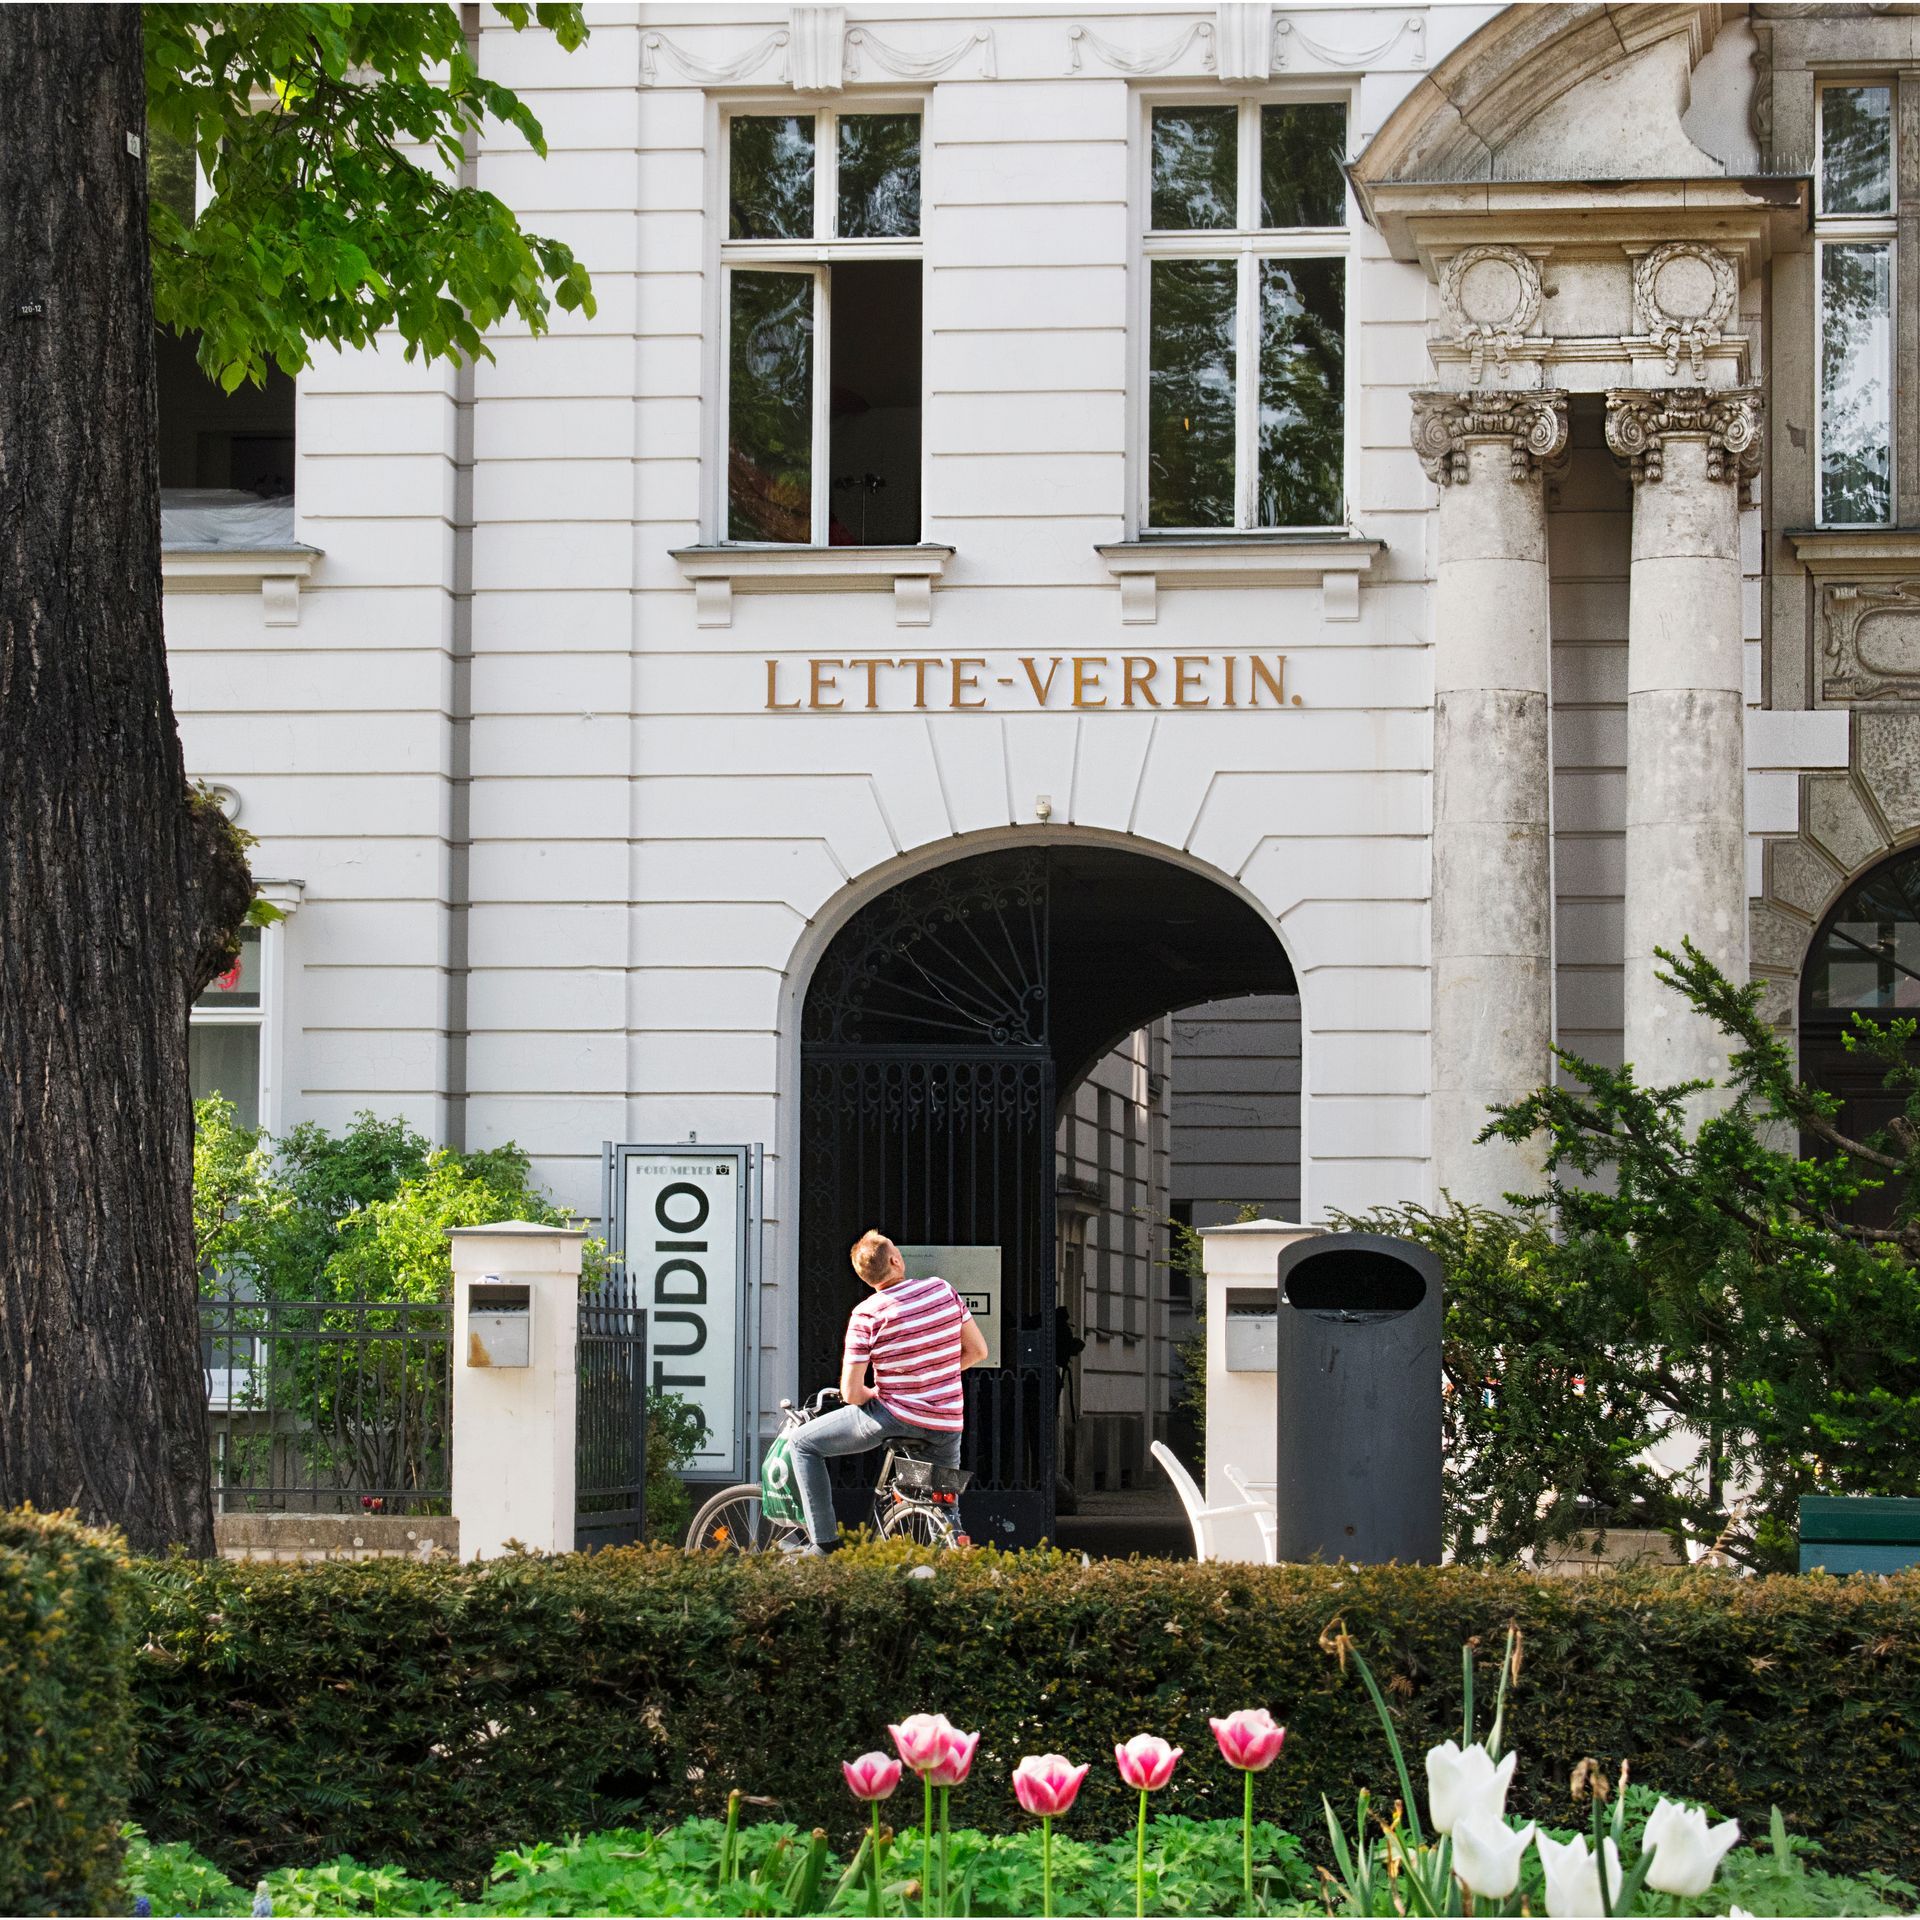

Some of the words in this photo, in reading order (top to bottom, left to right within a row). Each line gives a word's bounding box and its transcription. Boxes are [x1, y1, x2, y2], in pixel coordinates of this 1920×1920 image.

[764, 655, 1302, 709] LETTE-VEREIN.
[636, 1165, 667, 1175] FOTO
[671, 1165, 713, 1175] MEYER
